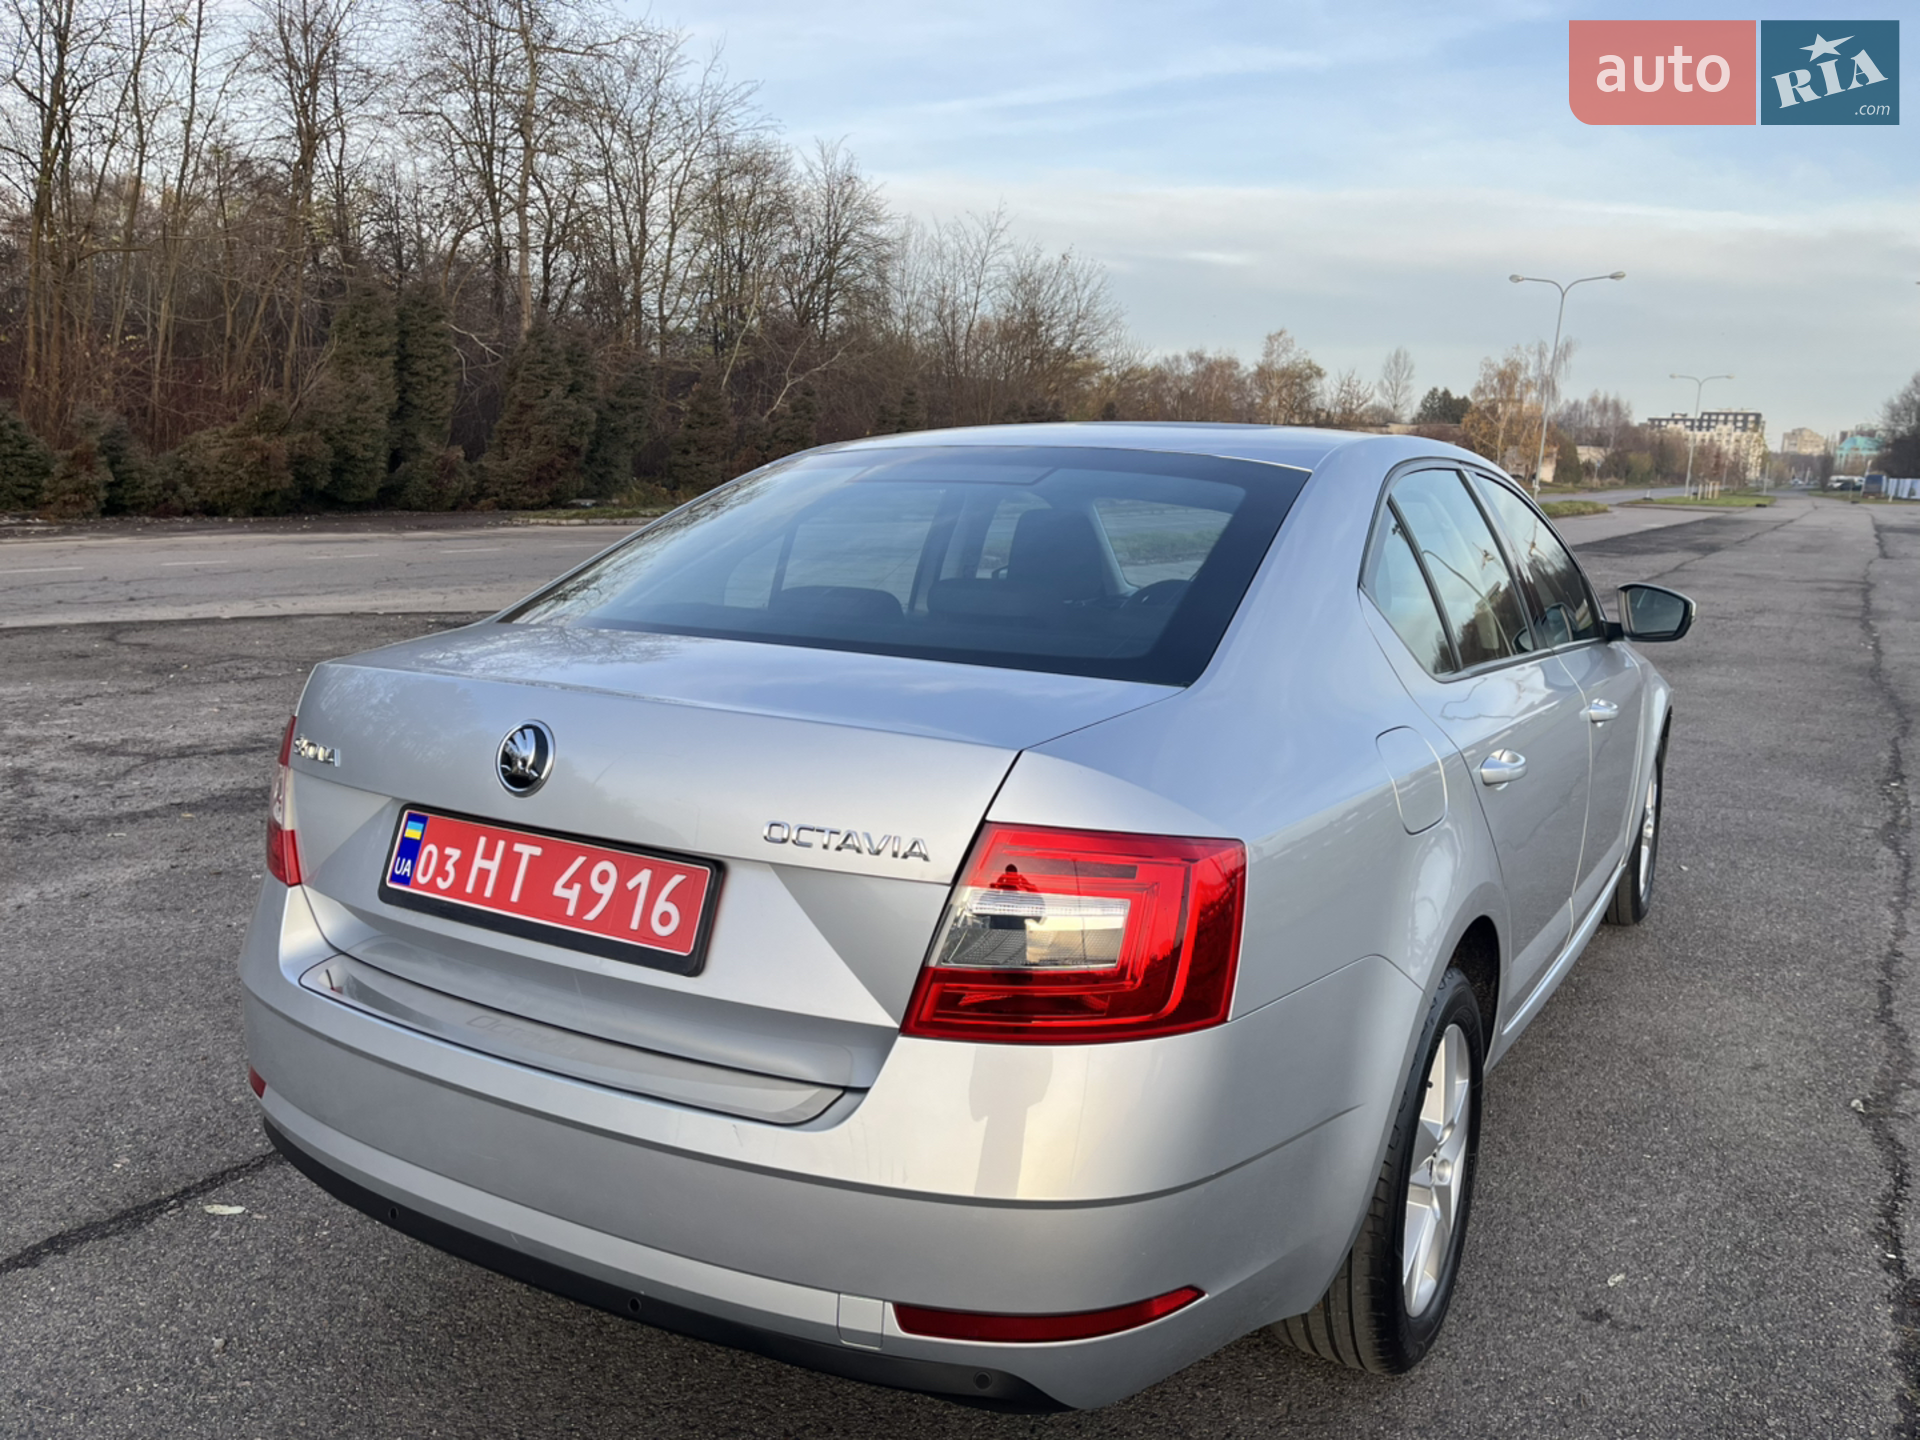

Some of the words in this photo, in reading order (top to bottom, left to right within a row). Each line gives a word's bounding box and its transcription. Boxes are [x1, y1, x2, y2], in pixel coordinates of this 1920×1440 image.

[762, 820, 930, 862] OCTAVIA
[394, 857, 412, 878] UA
[416, 843, 462, 890] 03
[465, 836, 543, 902] HT
[552, 855, 688, 937] 4916
